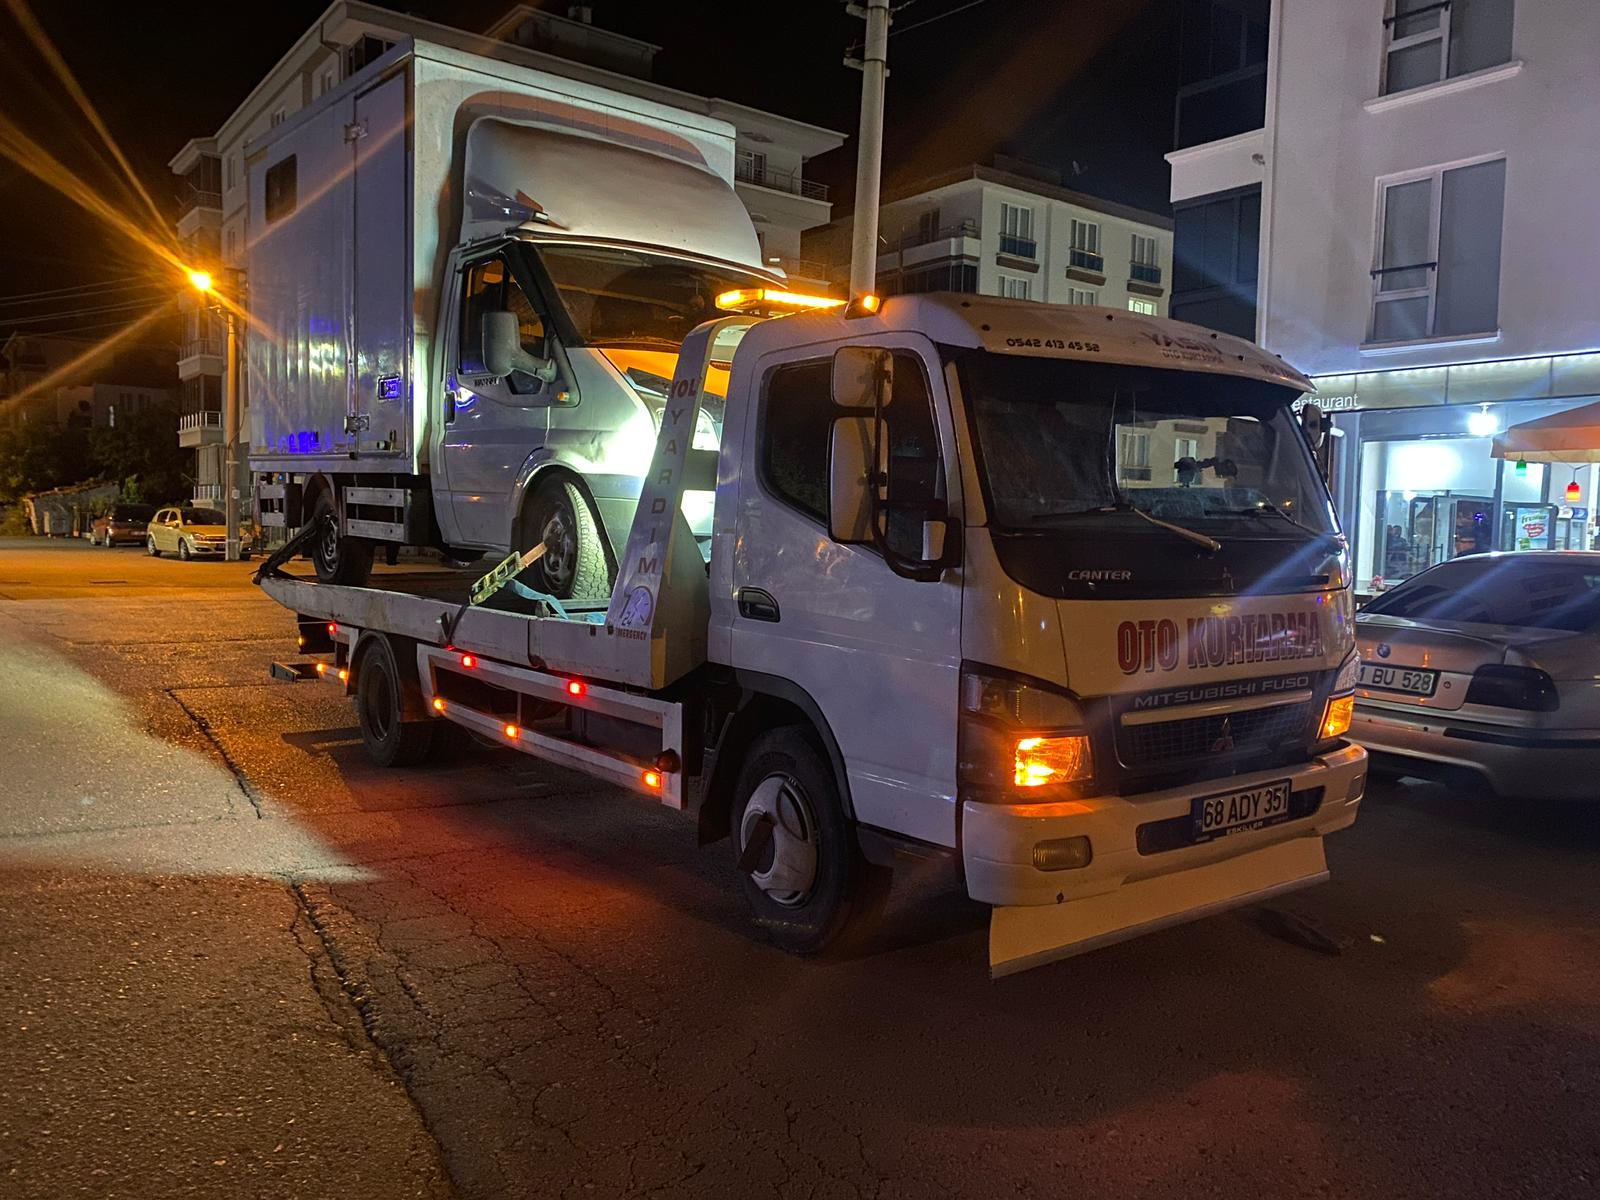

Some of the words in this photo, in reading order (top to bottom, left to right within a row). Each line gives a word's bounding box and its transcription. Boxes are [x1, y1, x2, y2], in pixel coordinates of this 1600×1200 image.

[1006, 338, 1041, 348] 0542
[1045, 340, 1065, 349] 413
[1068, 341, 1083, 351] 45
[1085, 343, 1100, 352] 52
[671, 378, 697, 398] YOL
[1290, 393, 1359, 411] estaurant
[1068, 570, 1131, 581] CANTER
[1117, 620, 1179, 674] OTO
[1186, 611, 1324, 669] KURTARMA
[1372, 669, 1396, 685] BU
[1402, 672, 1433, 691] 528
[1134, 682, 1257, 708] MITSUBISHI
[1261, 676, 1310, 692] FUSO
[1204, 800, 1224, 829] 68
[1227, 791, 1262, 824] ADY
[1264, 785, 1288, 815] 351
